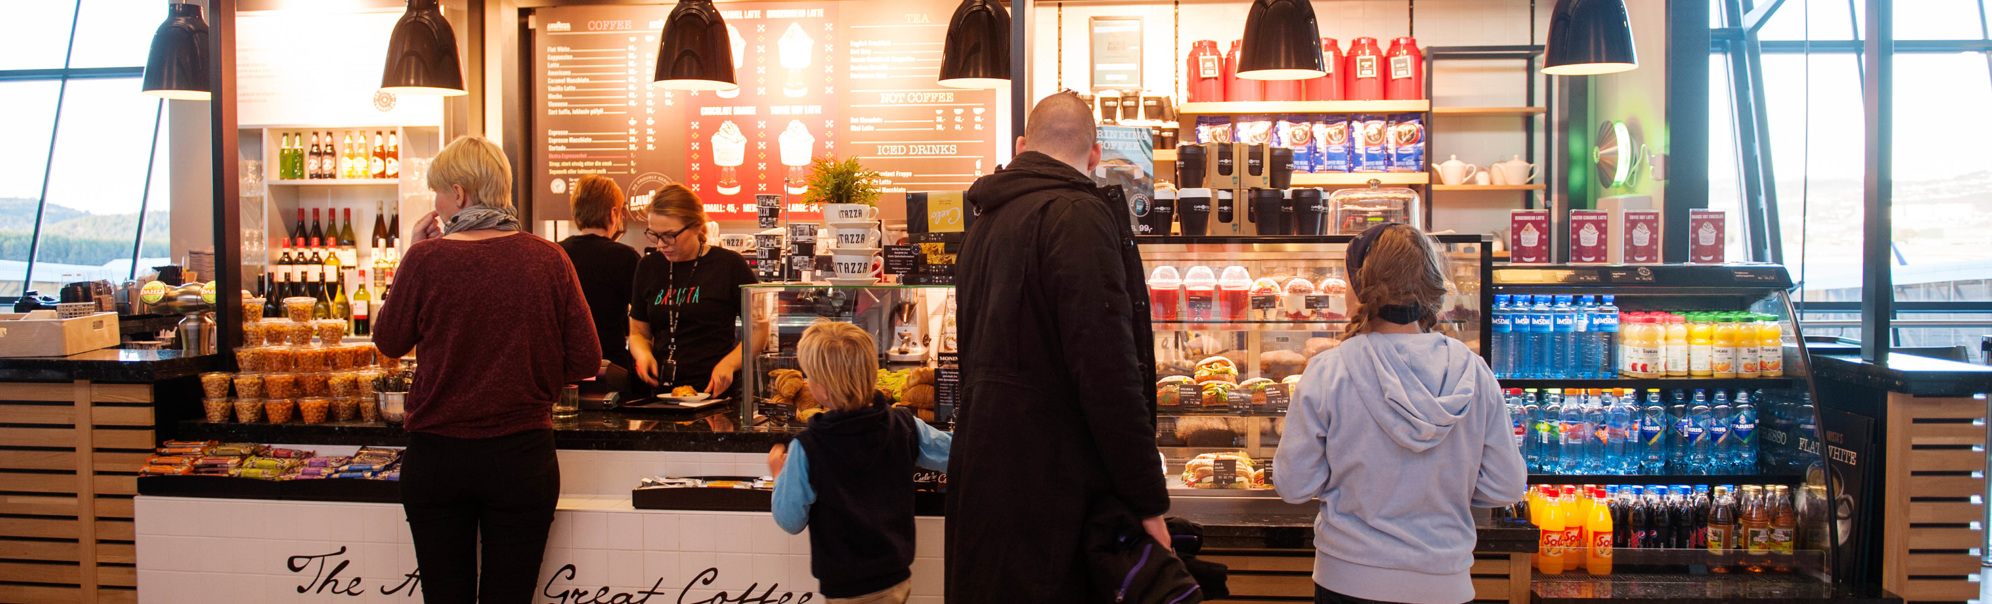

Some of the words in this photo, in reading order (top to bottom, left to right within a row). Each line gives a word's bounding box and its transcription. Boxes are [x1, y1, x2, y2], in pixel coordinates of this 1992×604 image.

[744, 10, 761, 19] LATTE
[807, 8, 824, 18] LATTE
[904, 13, 930, 24] TEA
[588, 20, 632, 31] COFFEE
[880, 93, 905, 104] NOT
[907, 92, 954, 103] COFFEE
[701, 106, 732, 116] CHOCOLATE
[804, 105, 822, 114] LATTE
[1096, 129, 1149, 141] RINKING
[877, 145, 906, 155] ICED
[908, 144, 958, 155] DRINKS
[638, 175, 658, 188] PROUDLY
[703, 204, 726, 213] SMALL:
[727, 204, 740, 214] 45,-
[788, 203, 810, 213] LARGE:
[1139, 224, 1153, 234] 99,-
[654, 287, 700, 306] BARISTA
[1798, 437, 1820, 456] FLAT
[287, 545, 364, 597] The
[543, 563, 665, 604] Great
[679, 566, 814, 604] Coffee
